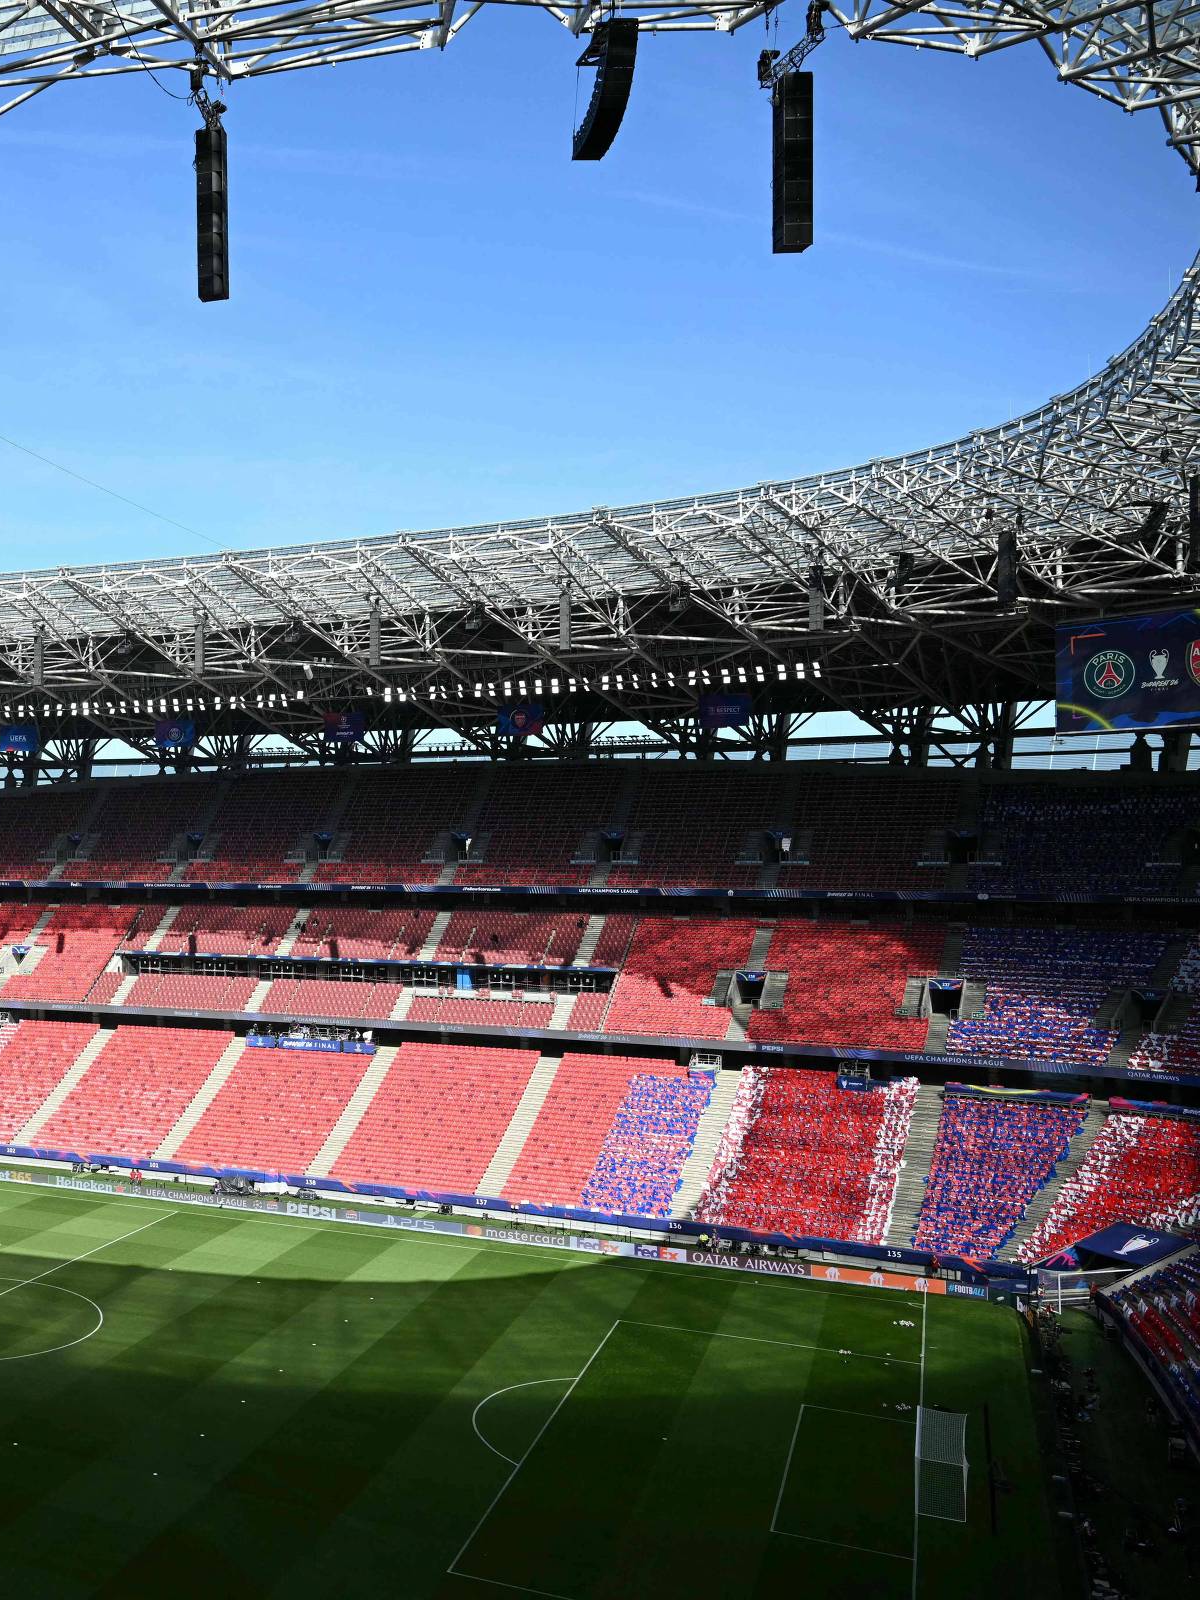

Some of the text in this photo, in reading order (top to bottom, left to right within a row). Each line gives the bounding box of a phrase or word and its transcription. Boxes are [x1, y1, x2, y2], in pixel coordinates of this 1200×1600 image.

[1092, 652, 1126, 665] PARIS
[925, 1056, 972, 1065] CHAMPIONS
[974, 1058, 1004, 1066] LEAGUE
[1128, 1071, 1180, 1082] QATAR AIRWAYS
[56, 1176, 113, 1193] Heineken
[146, 1188, 247, 1207] UEFA CHAMPIONS LEAGUE
[476, 1198, 488, 1206] 137
[286, 1202, 336, 1219] PEPSI
[401, 1219, 435, 1231] PS5
[668, 1222, 682, 1230] 136
[486, 1228, 565, 1246] mastercard
[577, 1240, 620, 1253] FedEx
[634, 1245, 678, 1260] FedEx
[887, 1250, 902, 1258] 135
[692, 1253, 804, 1274] QATAR AIRWAYS
[948, 1282, 985, 1296] #FOOTBALL
